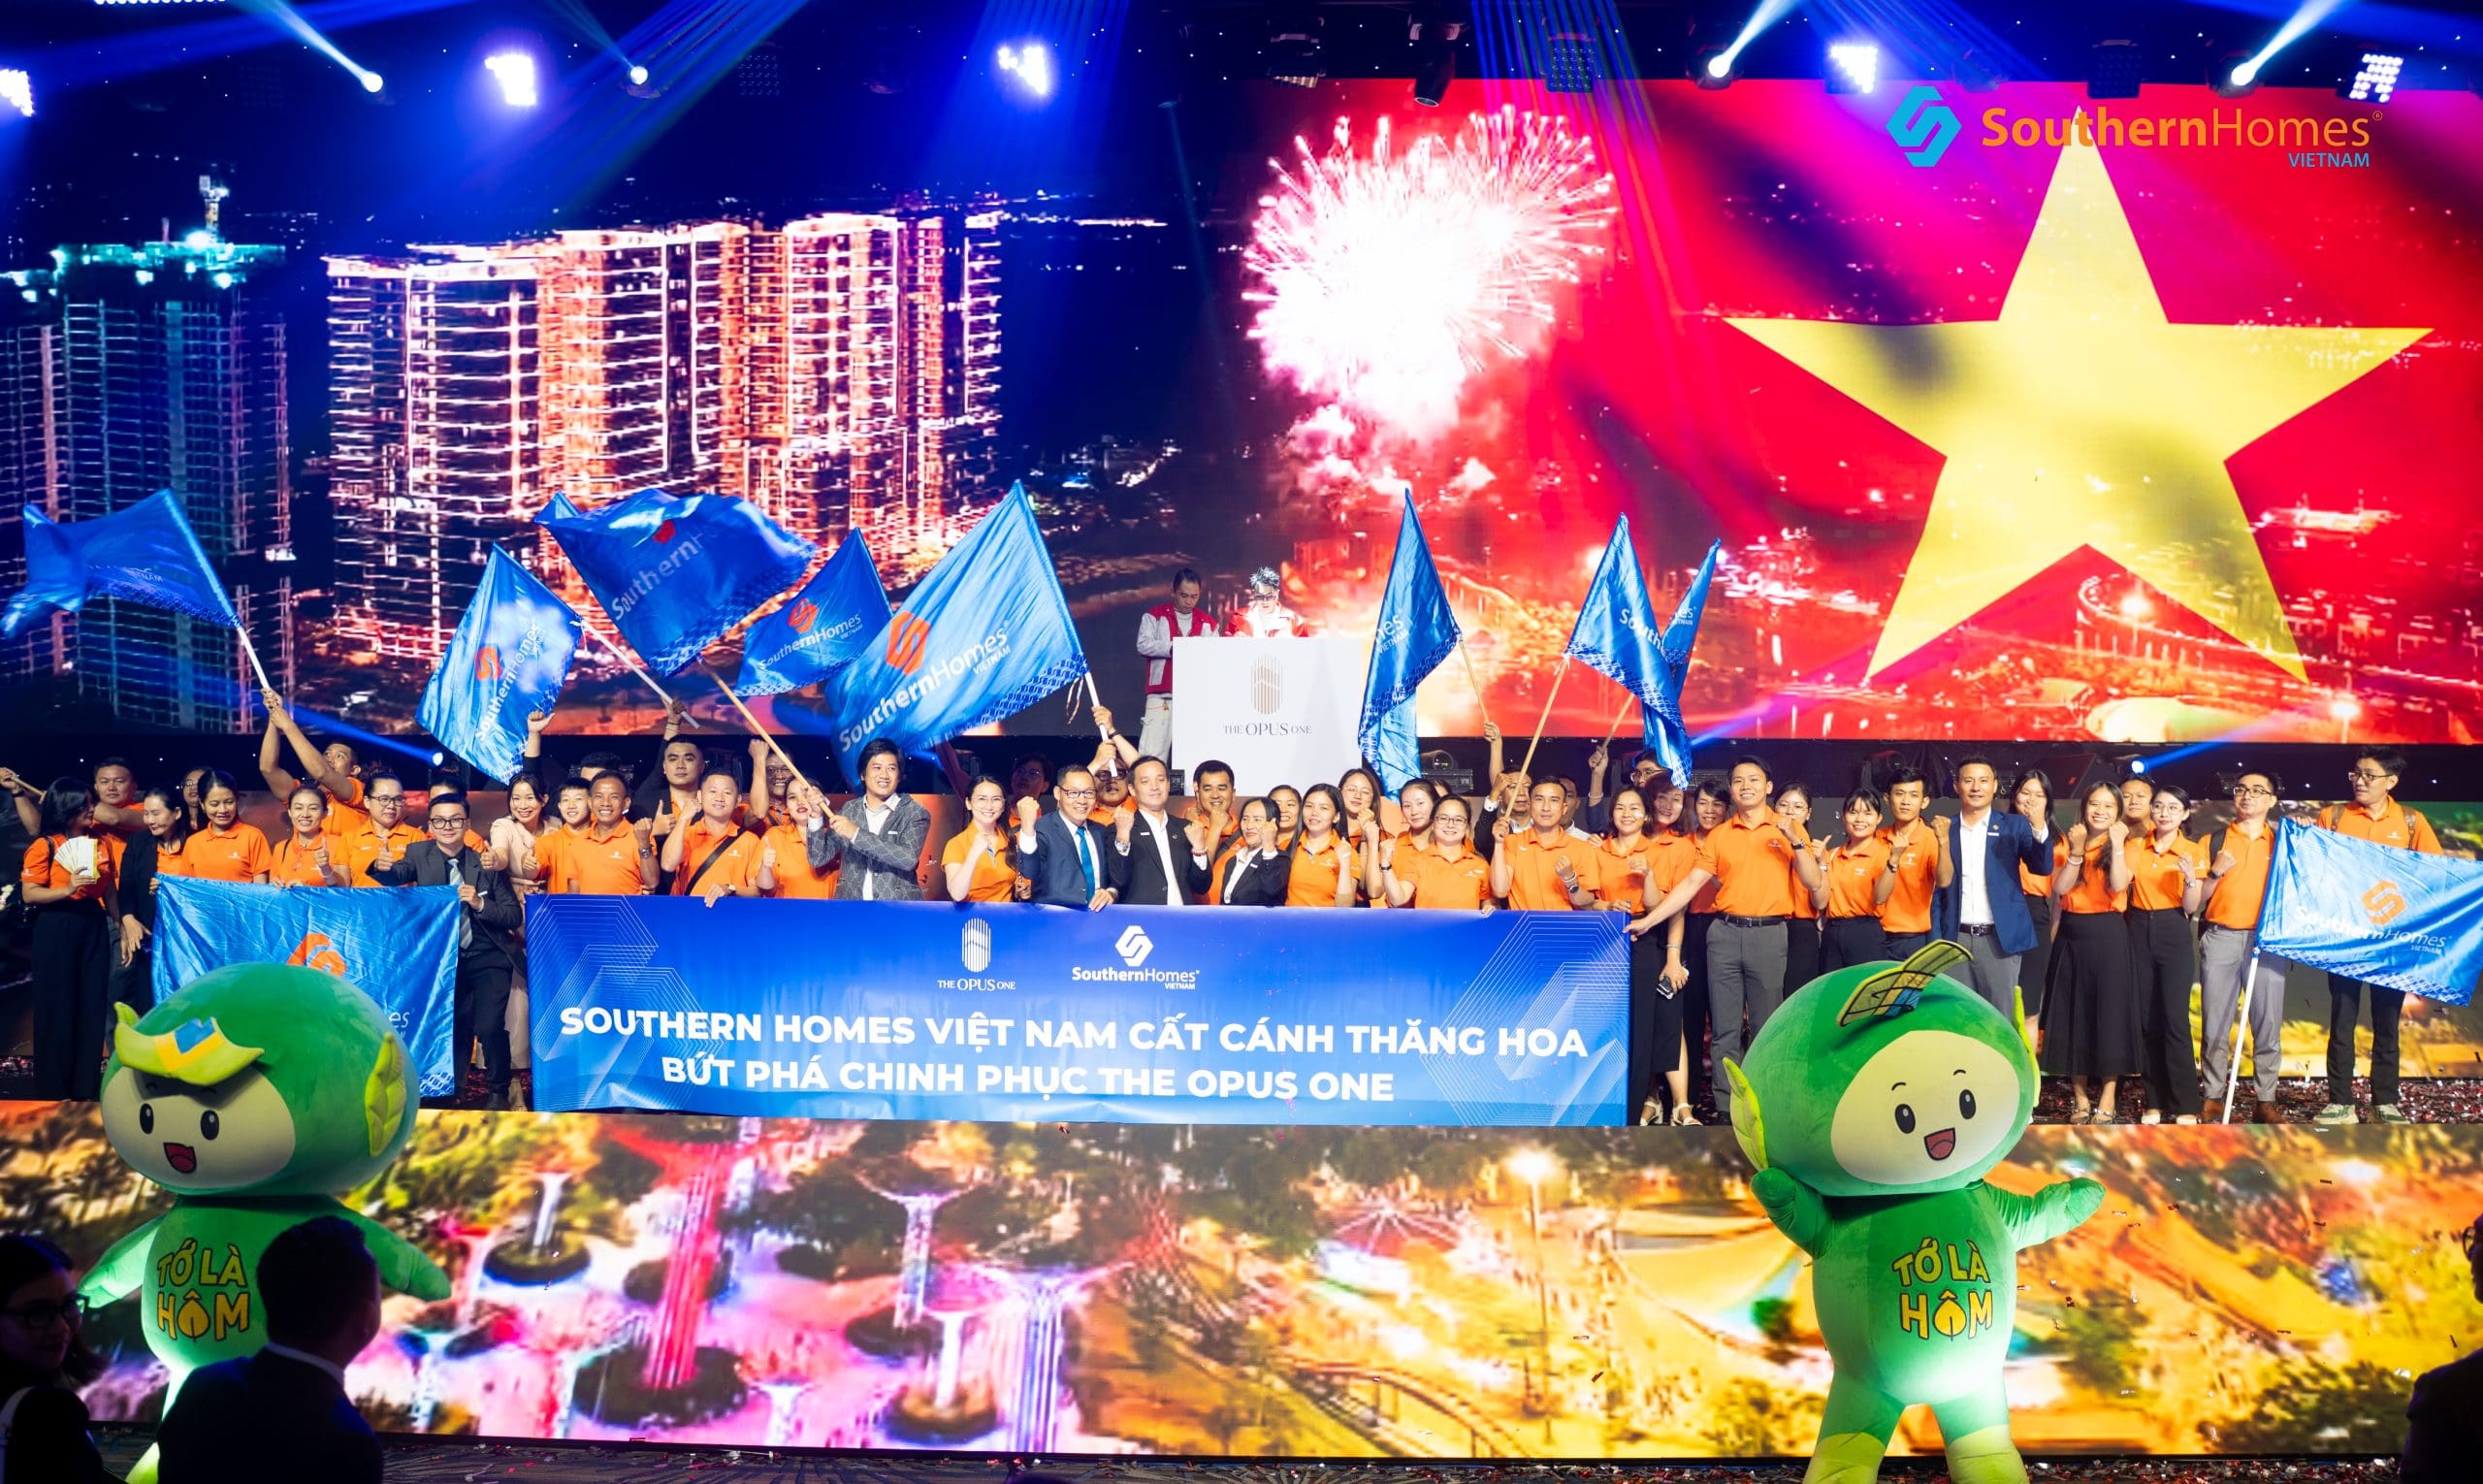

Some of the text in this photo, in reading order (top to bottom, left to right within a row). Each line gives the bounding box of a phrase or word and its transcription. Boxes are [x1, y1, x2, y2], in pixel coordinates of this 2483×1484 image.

[758, 613, 861, 669] SouthernHomes
[973, 645, 1011, 675] VIETNAM
[839, 627, 1008, 754] SouthernHomes
[1223, 722, 1312, 736] THE OPUS ONE
[1072, 966, 1196, 983] SouthernHomes
[2411, 944, 2442, 955] VIETNAM
[937, 978, 1016, 991] THE OPUS ONE
[560, 1007, 1589, 1057] SOUTHERN HOMES VIỆT NAM CẤT CÁNH THĂNG HOA
[661, 1050, 1394, 1102] BỨT PHÁ CHINH PHỤC THE OPUS ONE
[157, 1237, 247, 1287] TỚ LÀ
[1891, 1236, 1991, 1287] TỚ LÀ
[157, 1288, 250, 1342] HÔM
[1900, 1288, 1993, 1341] HÔM
